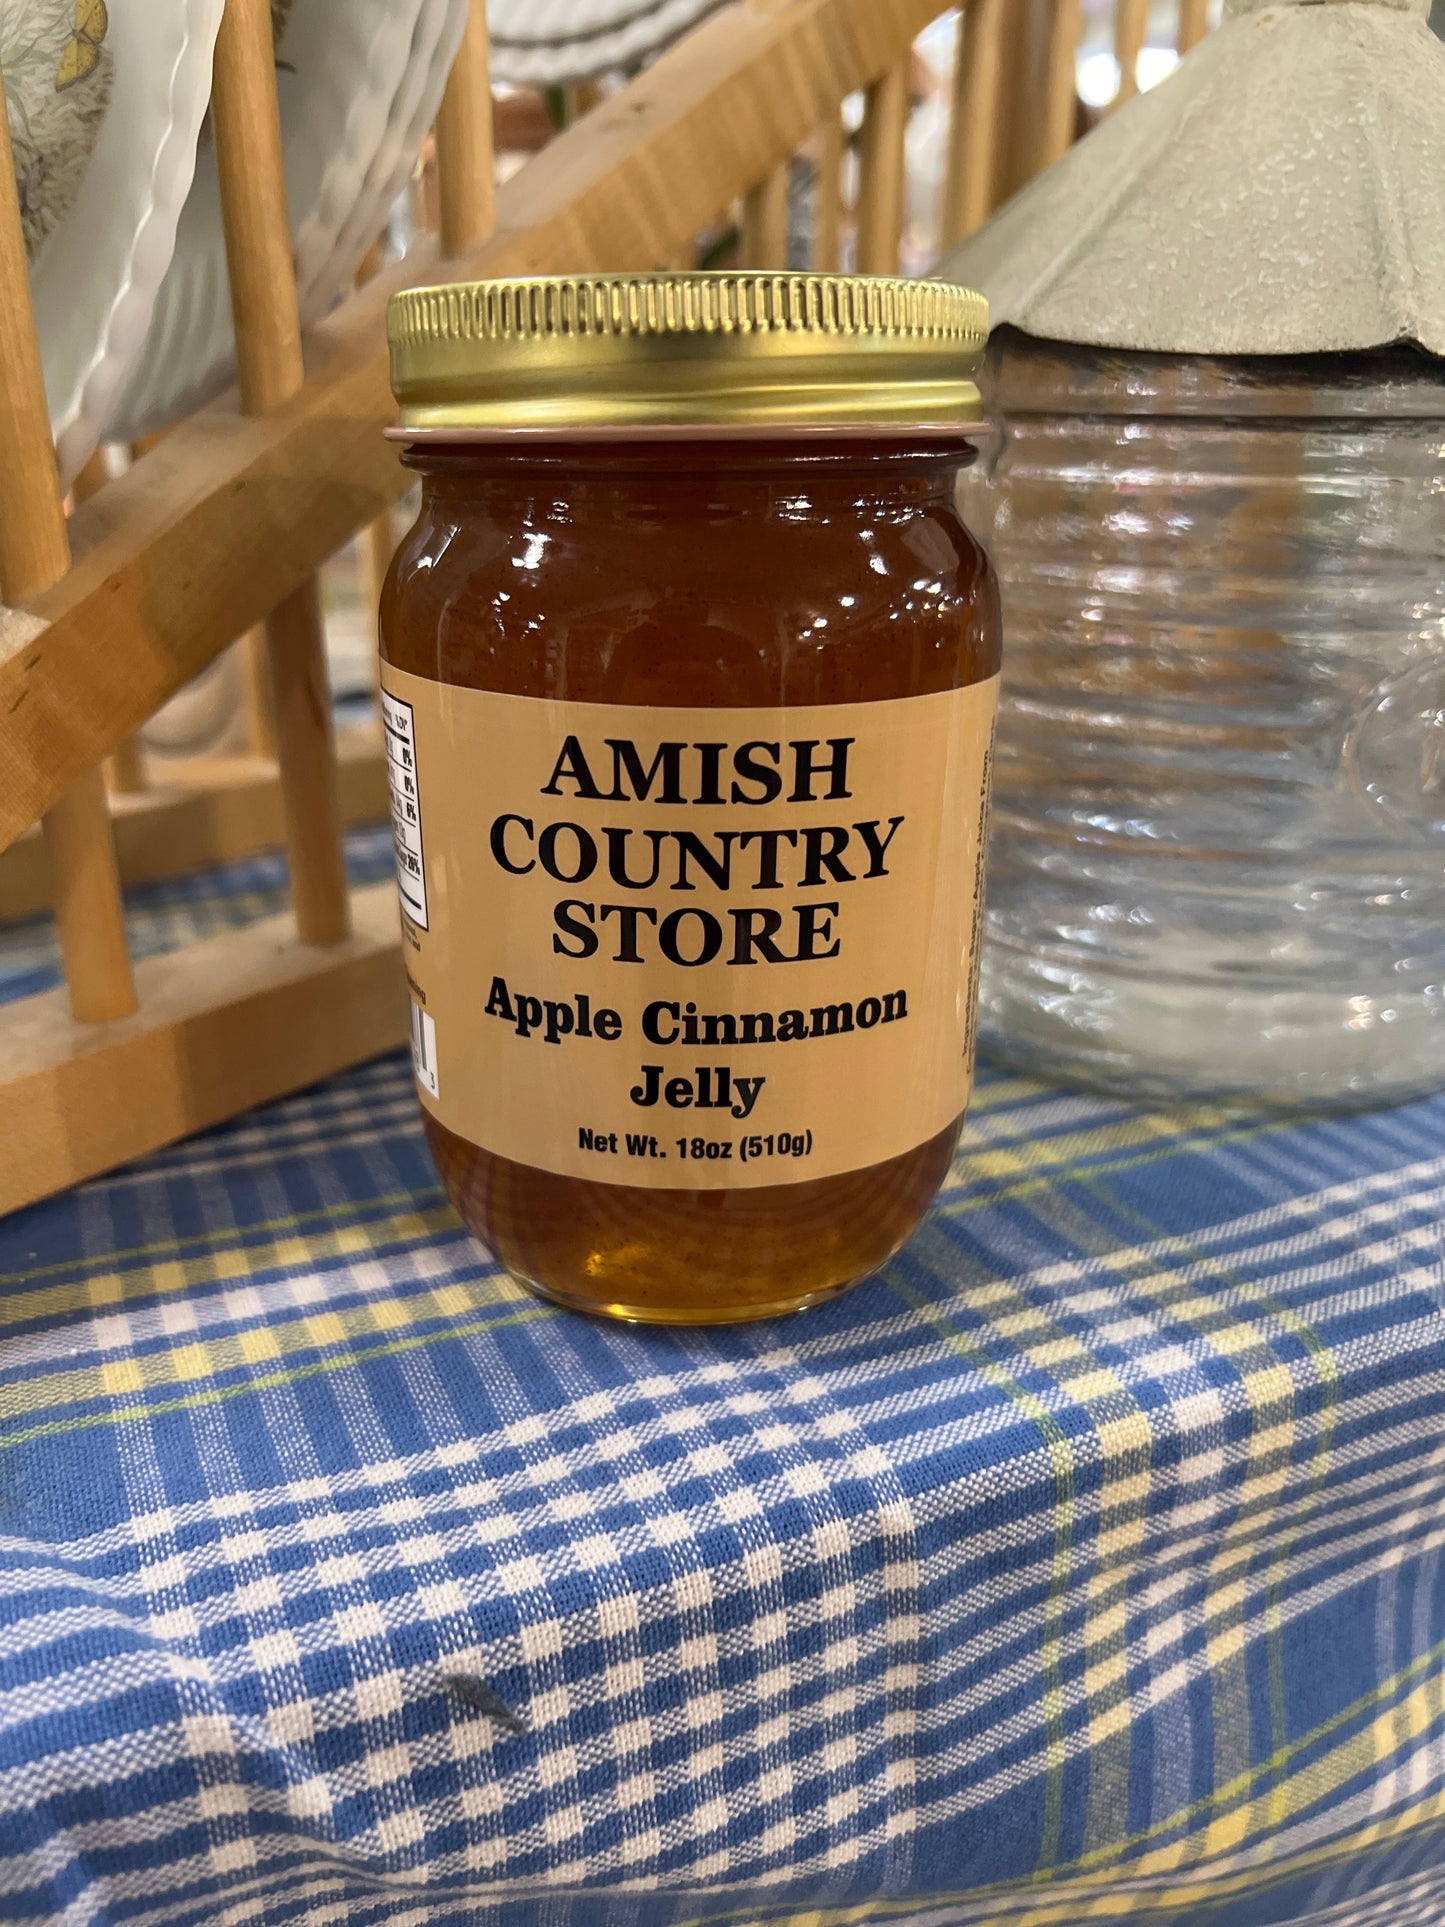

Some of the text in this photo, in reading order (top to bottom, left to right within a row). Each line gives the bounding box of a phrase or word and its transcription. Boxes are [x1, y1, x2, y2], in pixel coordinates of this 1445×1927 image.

[540, 735, 856, 806] AMISH
[489, 813, 905, 891] COUNTRY
[972, 851, 981, 900] Apple
[552, 899, 841, 967] STORE
[484, 976, 908, 1046] Apple Cinnamon
[629, 1064, 766, 1119] Jelly
[578, 1127, 813, 1163] Net Wt. 18oz (510g)
